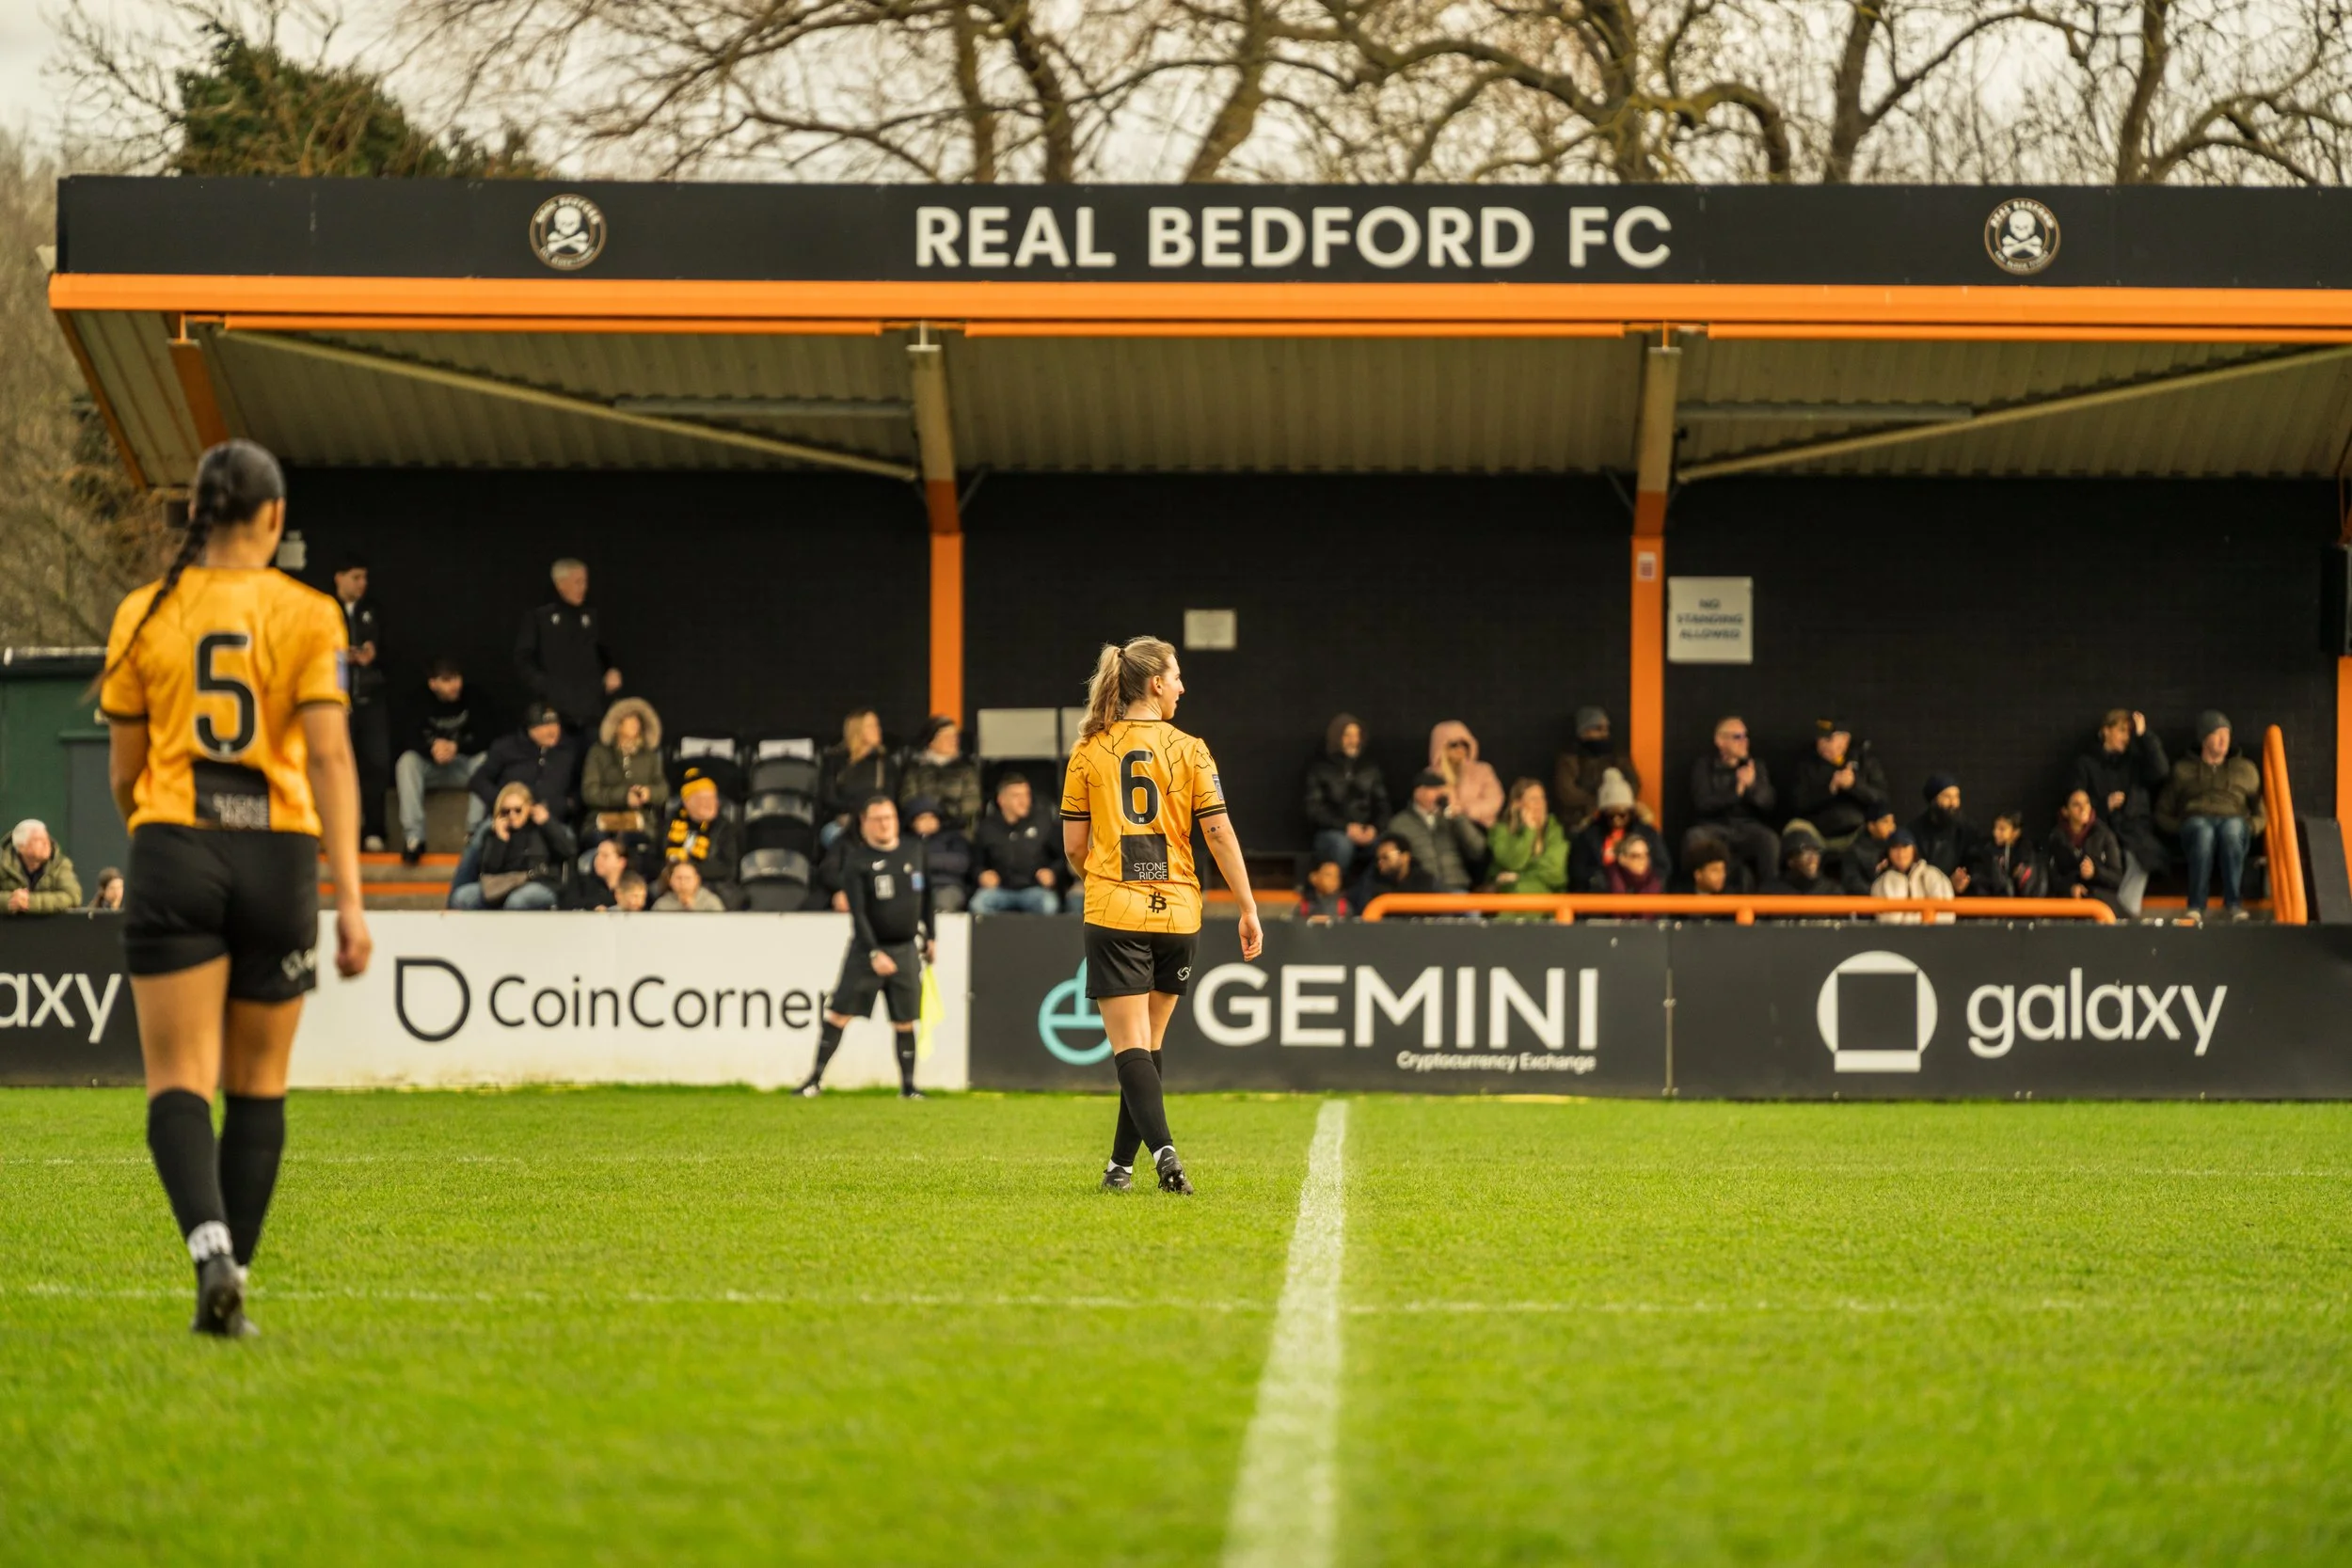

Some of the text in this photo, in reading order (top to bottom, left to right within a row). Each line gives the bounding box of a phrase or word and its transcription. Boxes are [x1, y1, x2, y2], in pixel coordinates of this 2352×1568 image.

[916, 206, 1672, 268] REAL BEDFORD FC
[195, 632, 256, 758] 5
[1120, 750, 1158, 825] 6
[1134, 862, 1167, 872] STONE
[1138, 871, 1168, 880] RIDGE
[1193, 962, 1598, 1050] GEMINI
[1966, 967, 2228, 1058] galaxy
[1396, 1051, 1597, 1075] Cryptocurrency Exchange
